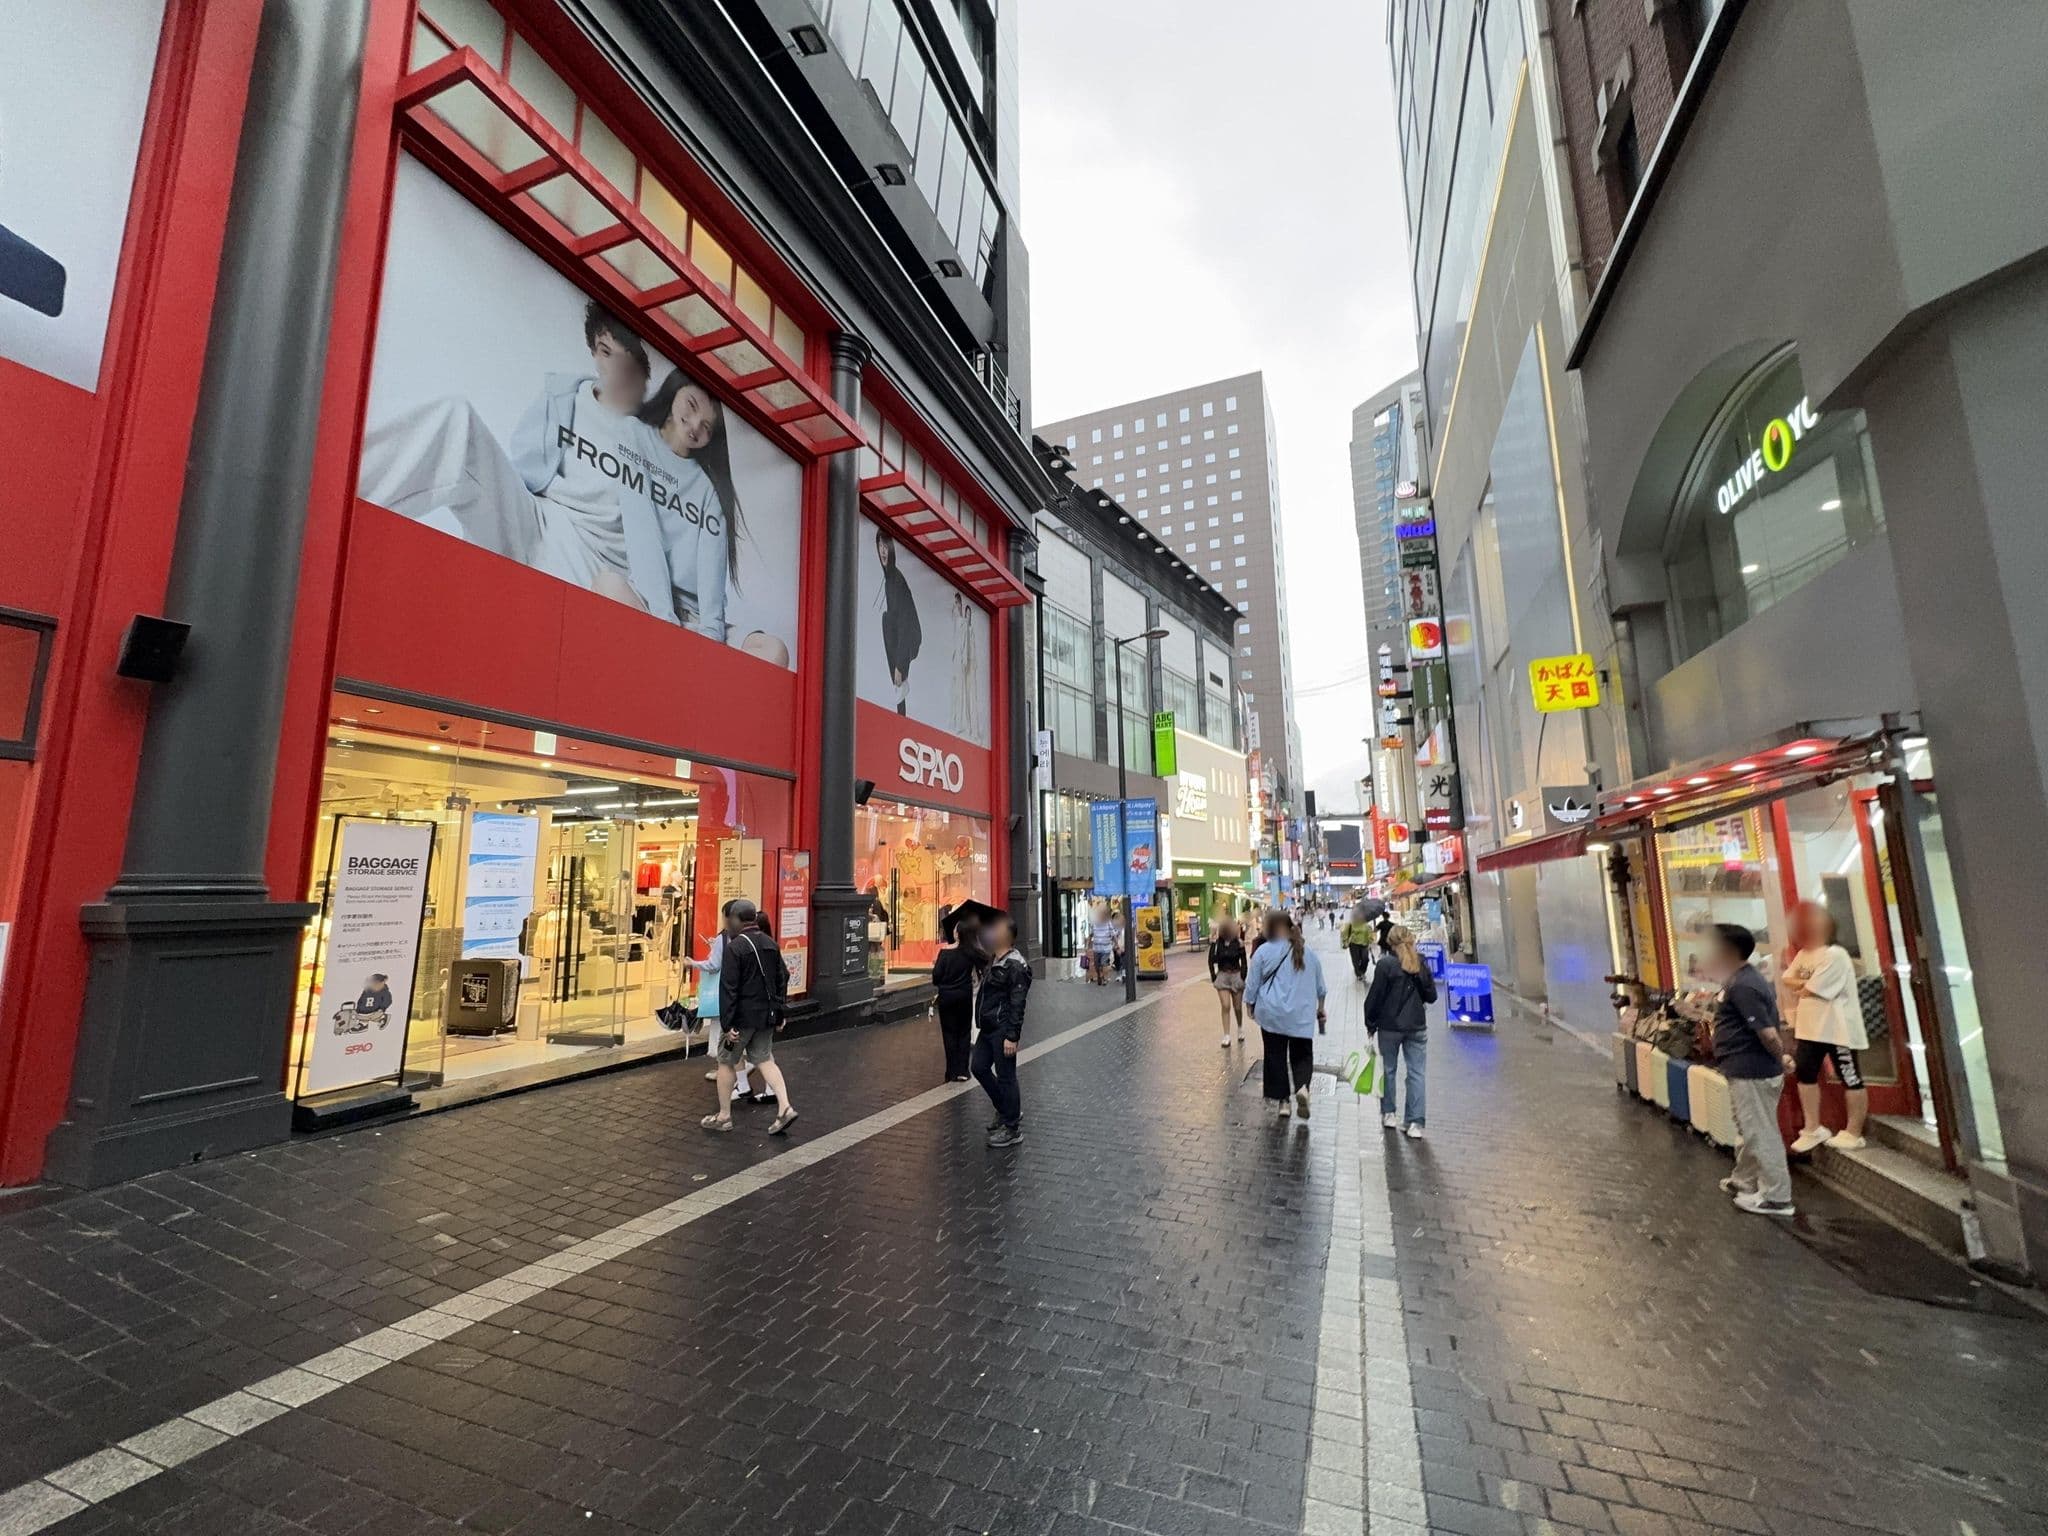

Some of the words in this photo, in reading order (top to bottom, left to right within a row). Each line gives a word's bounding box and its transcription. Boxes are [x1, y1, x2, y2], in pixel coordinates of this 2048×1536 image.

[557, 424, 643, 494] FROM
[650, 479, 721, 537] BASIC
[1717, 447, 1765, 514] OLIVE
[1397, 521, 1435, 538] Mud
[1537, 661, 1594, 682] かばん
[1545, 681, 1590, 701] 天国
[1155, 712, 1172, 723] ABC
[899, 738, 964, 793] SPAO
[1430, 775, 1452, 797] 光
[348, 856, 420, 869] BAGGAGE
[347, 868, 385, 876] STORAGE
[1447, 967, 1488, 979] OPENING
[1448, 978, 1480, 988] HOURS
[345, 1042, 373, 1055] SPAO
